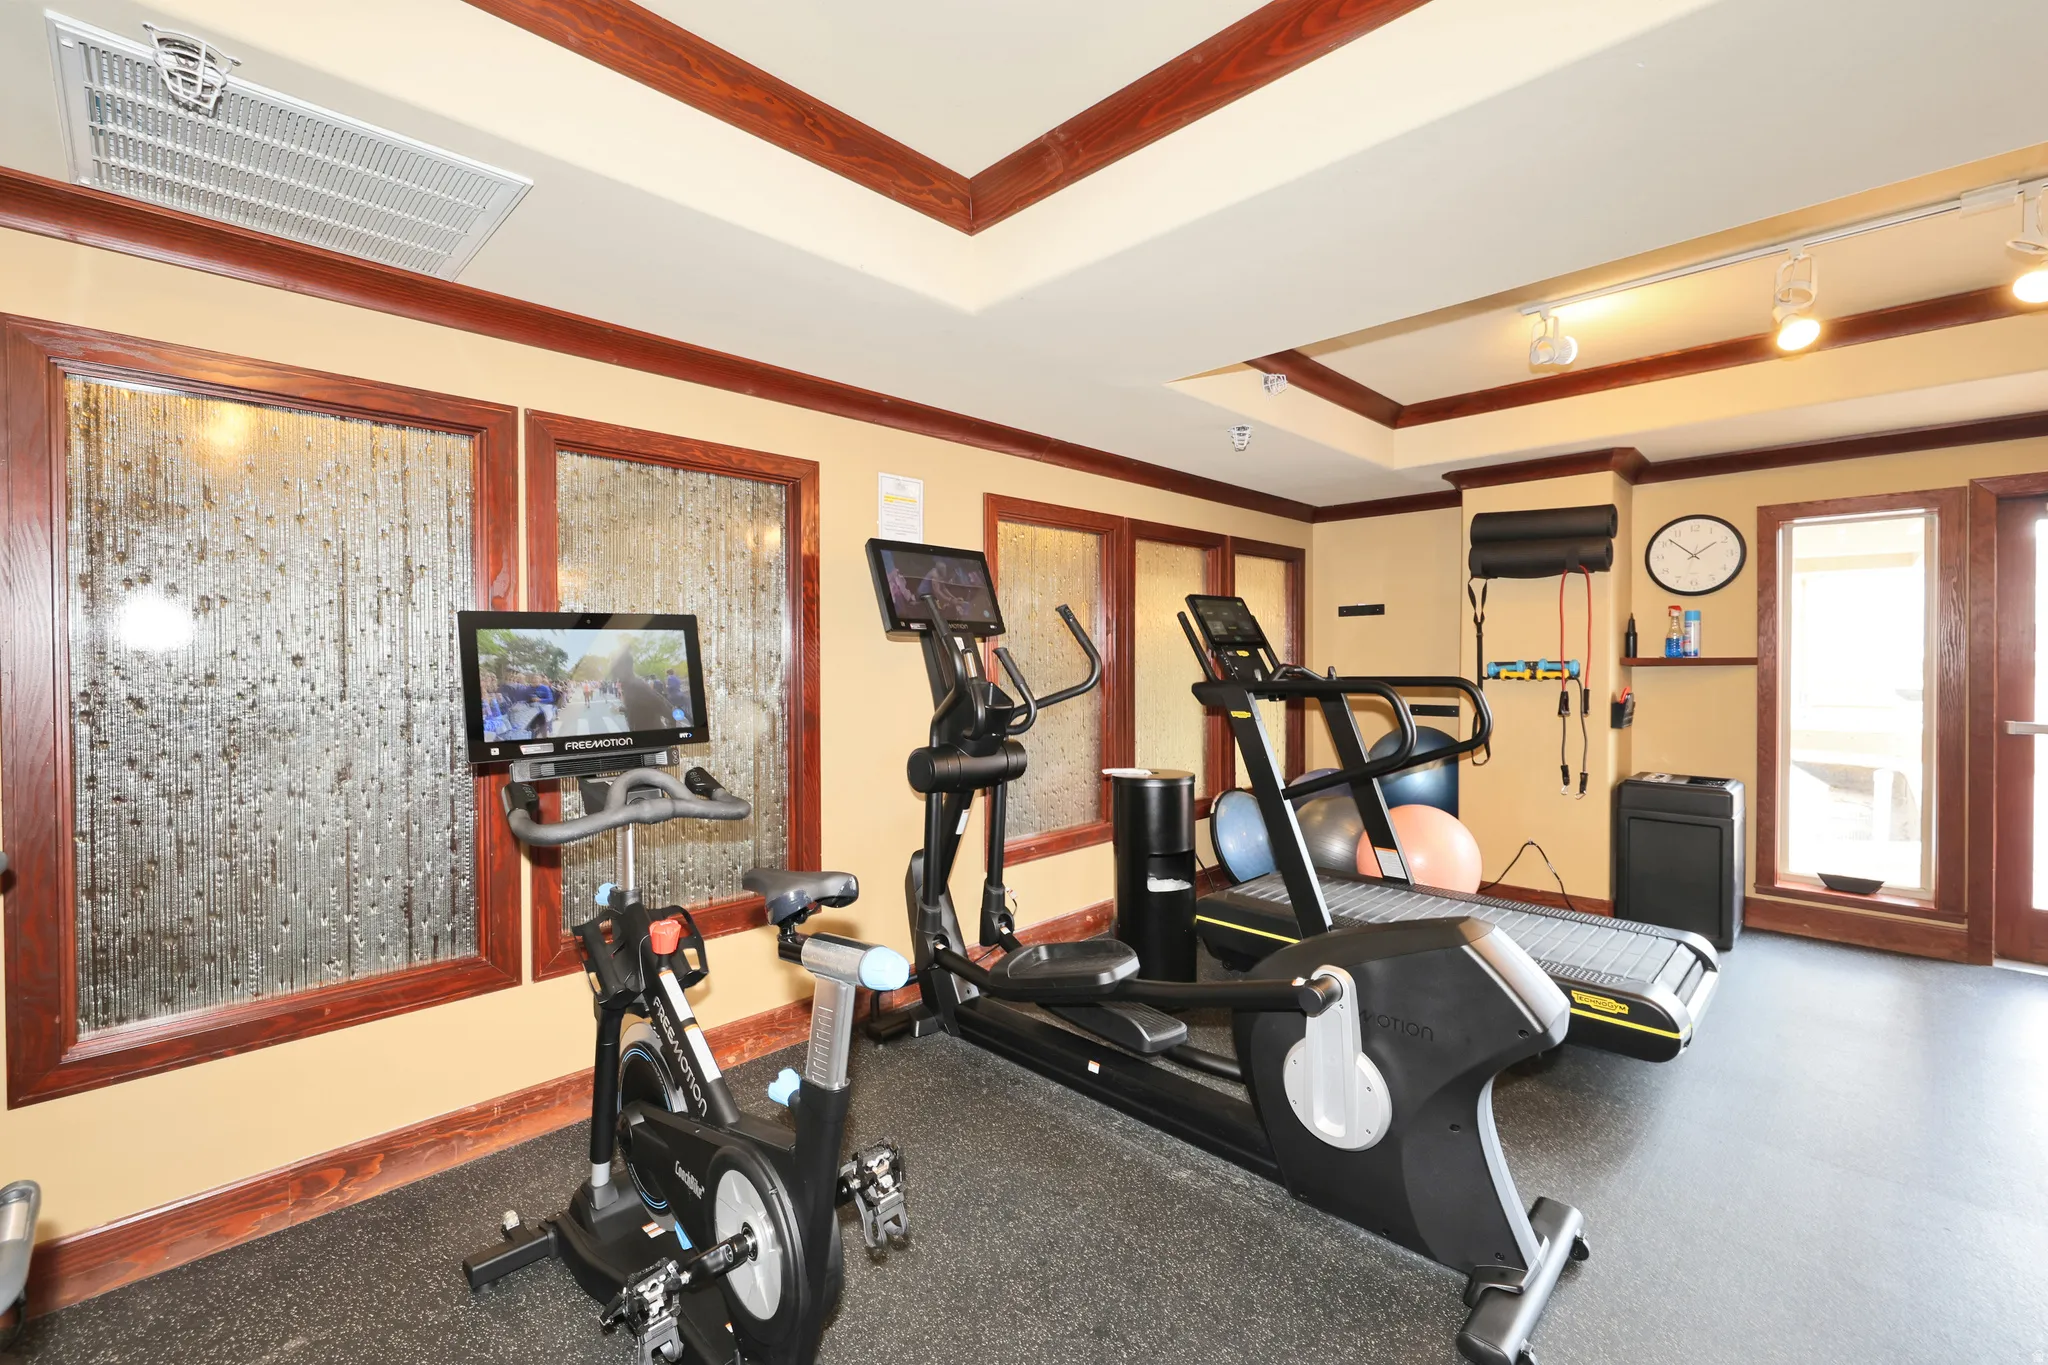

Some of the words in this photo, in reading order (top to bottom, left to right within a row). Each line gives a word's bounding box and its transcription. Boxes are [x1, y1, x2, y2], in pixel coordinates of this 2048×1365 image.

[1690, 524, 1701, 532] 12
[1674, 529, 1682, 538] 11
[1720, 536, 1729, 544] 2
[1726, 549, 1734, 557] 3
[1675, 576, 1682, 584] 7
[1690, 578, 1699, 586] 6
[565, 737, 633, 751] FREEMOTION
[1359, 1009, 1434, 1042] MOTION
[653, 996, 708, 1118] FREEMOTION
